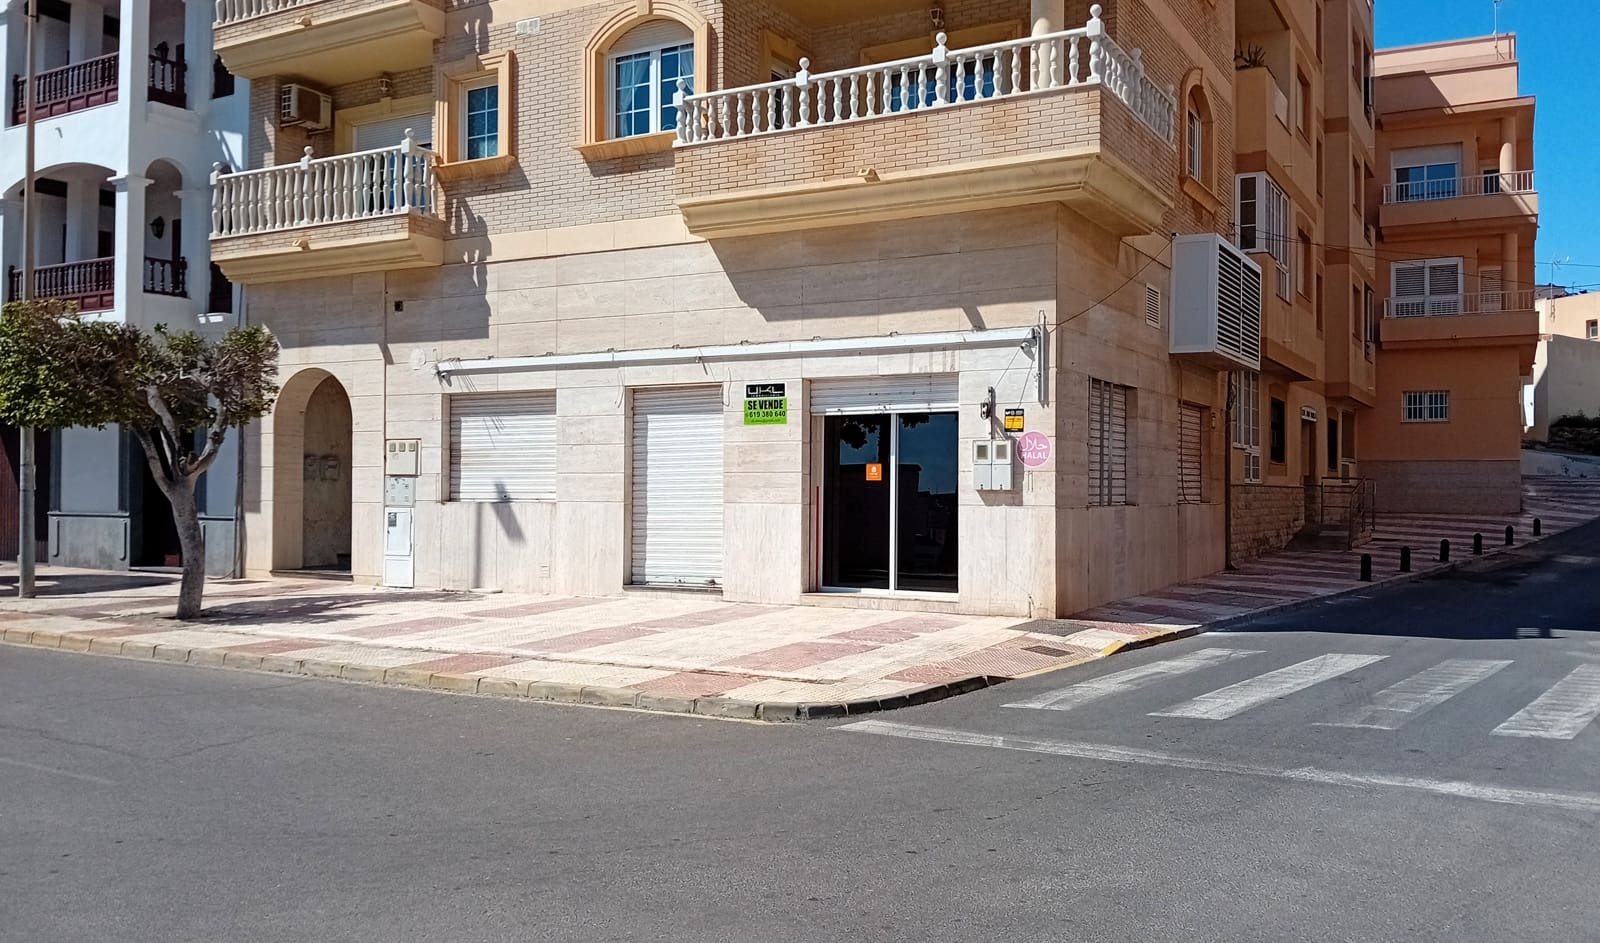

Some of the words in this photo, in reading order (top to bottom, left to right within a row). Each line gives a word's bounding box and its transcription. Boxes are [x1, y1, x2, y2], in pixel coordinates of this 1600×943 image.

[747, 400, 757, 410] SE
[759, 399, 783, 410] VENDE
[1020, 436, 1048, 451] حلال
[1021, 451, 1047, 459] HALAL
